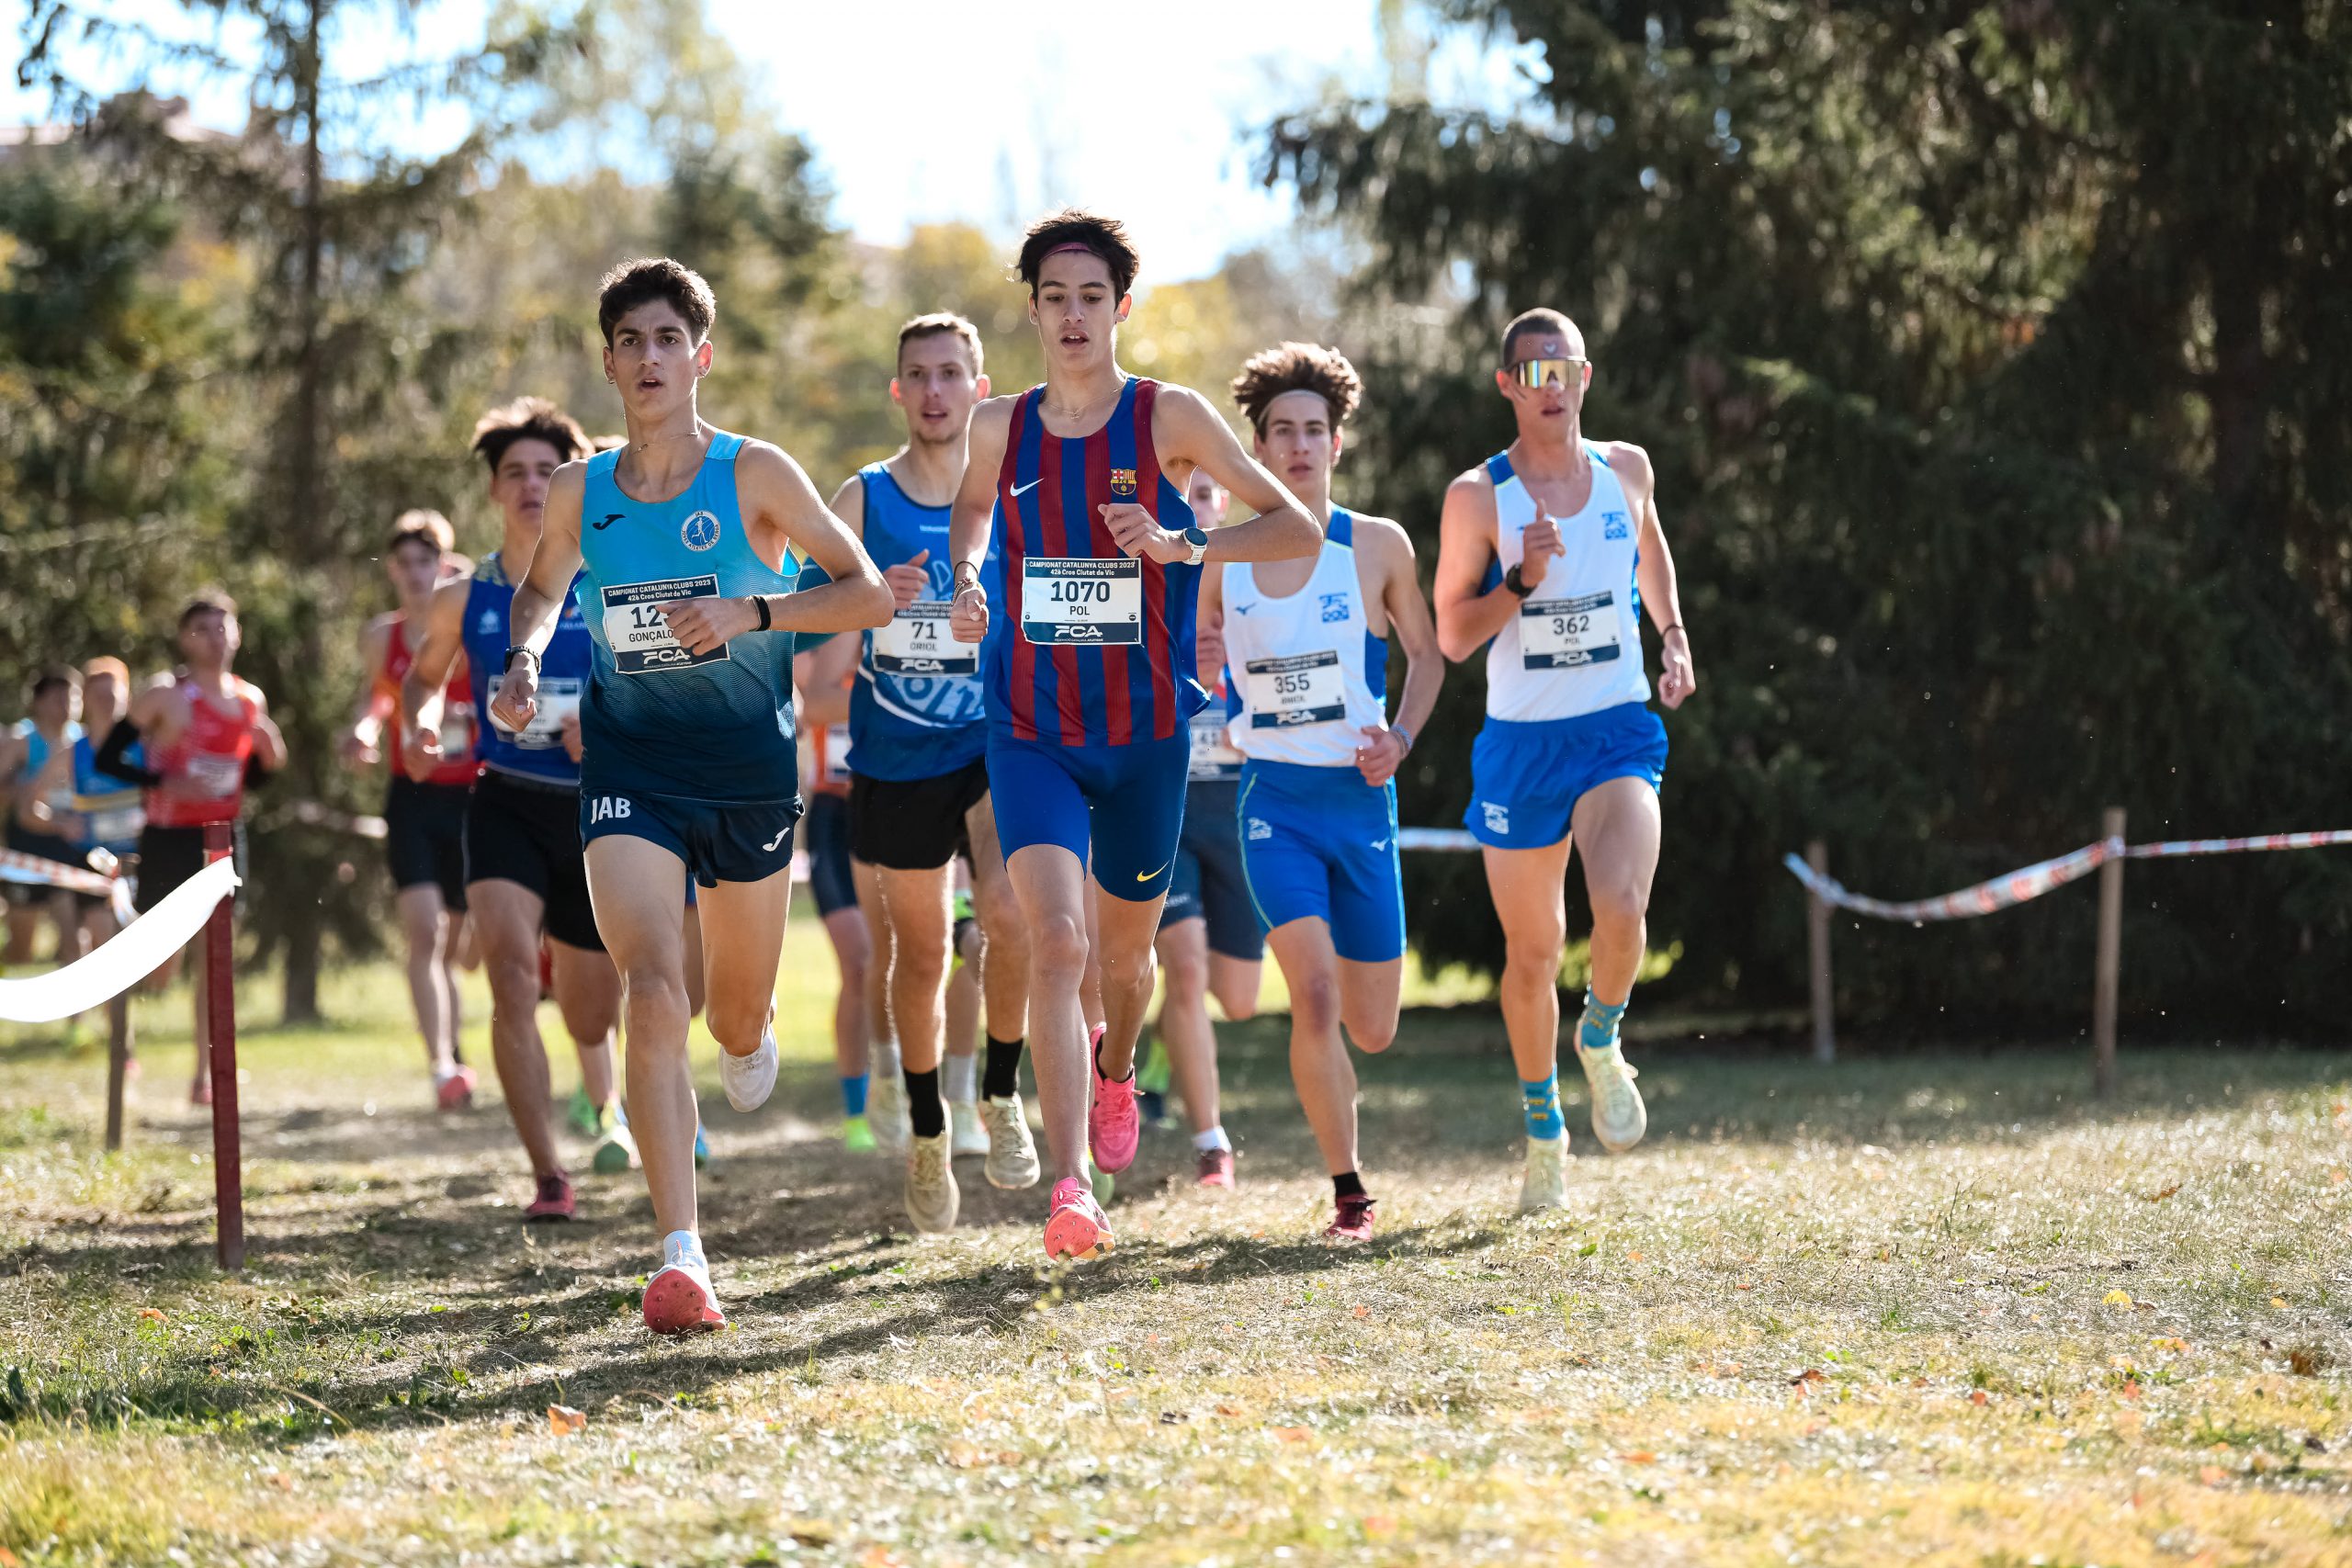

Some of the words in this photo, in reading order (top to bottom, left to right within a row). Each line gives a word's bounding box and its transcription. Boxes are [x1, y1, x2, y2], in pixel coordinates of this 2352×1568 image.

[607, 588, 639, 597] CAMPIONAT
[639, 584, 673, 593] CATALUNYA
[673, 581, 694, 590] CLUBS
[694, 579, 711, 588] 2023
[1050, 581, 1111, 603] 1070
[639, 592, 655, 601] Cros
[630, 604, 668, 629] 12
[1069, 605, 1091, 615] POL
[911, 621, 937, 640] 71
[1055, 625, 1103, 637] FCA
[1553, 615, 1589, 635] 362
[628, 629, 673, 643] GONÇALO
[910, 642, 937, 652] ORIOL
[643, 649, 692, 665] FCA
[900, 659, 945, 671] FCA
[1552, 650, 1593, 667] FCA
[1274, 673, 1310, 694] 355
[1276, 709, 1317, 725] FCA
[591, 796, 631, 825] JAB
